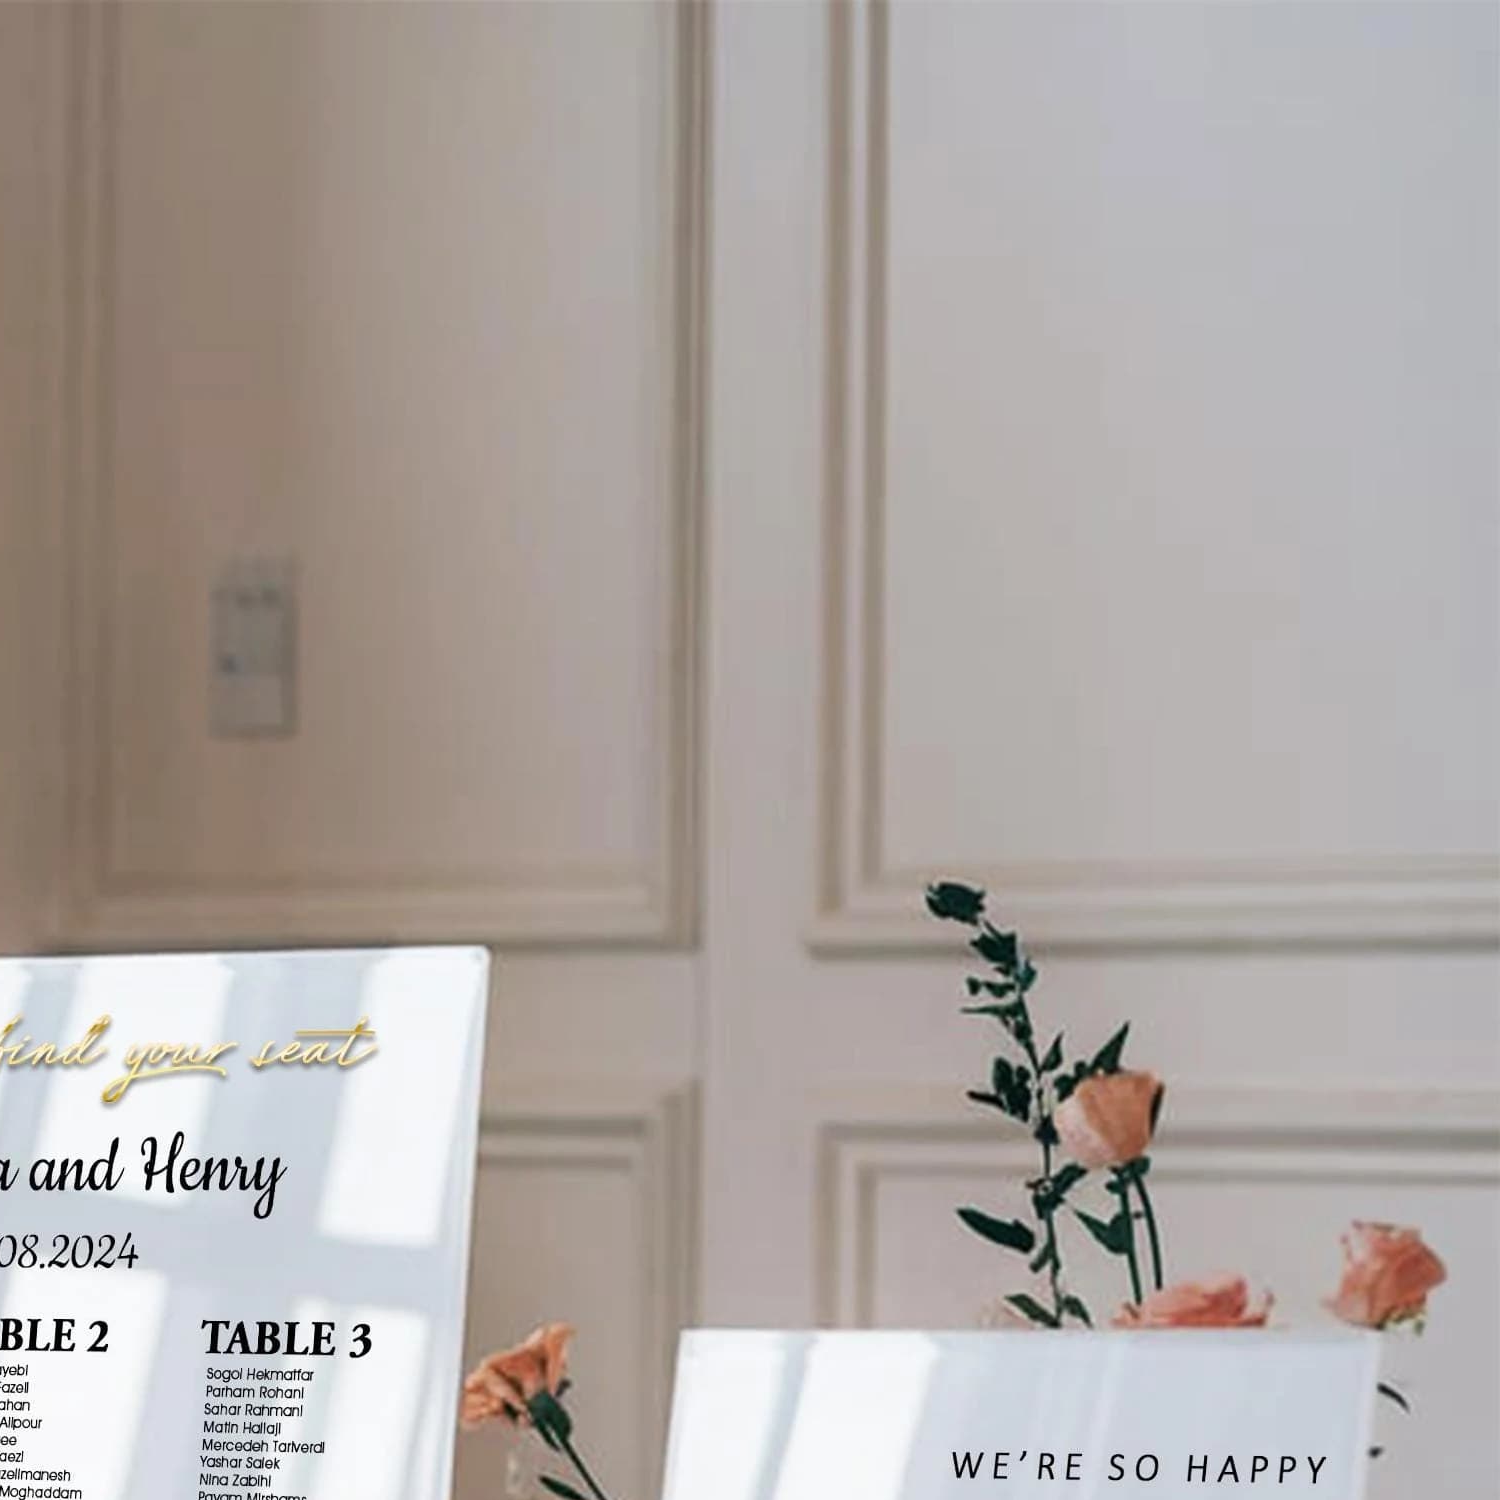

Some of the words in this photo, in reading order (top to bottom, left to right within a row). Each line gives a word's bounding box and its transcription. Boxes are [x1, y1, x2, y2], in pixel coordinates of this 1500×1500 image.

[100, 1038, 237, 1102] your
[249, 1018, 378, 1070] seat
[28, 1136, 125, 1192] and
[140, 1130, 289, 1220] Henry
[86, 1320, 109, 1353] 2
[200, 1319, 336, 1357] TABLE
[348, 1323, 373, 1359] 3
[205, 1384, 256, 1399] Parham
[206, 1367, 243, 1384] Sogol
[199, 1455, 243, 1469] Yashar
[245, 1456, 281, 1470] Salek
[1107, 1453, 1159, 1482] SO
[1186, 1454, 1327, 1485] HAPPY
